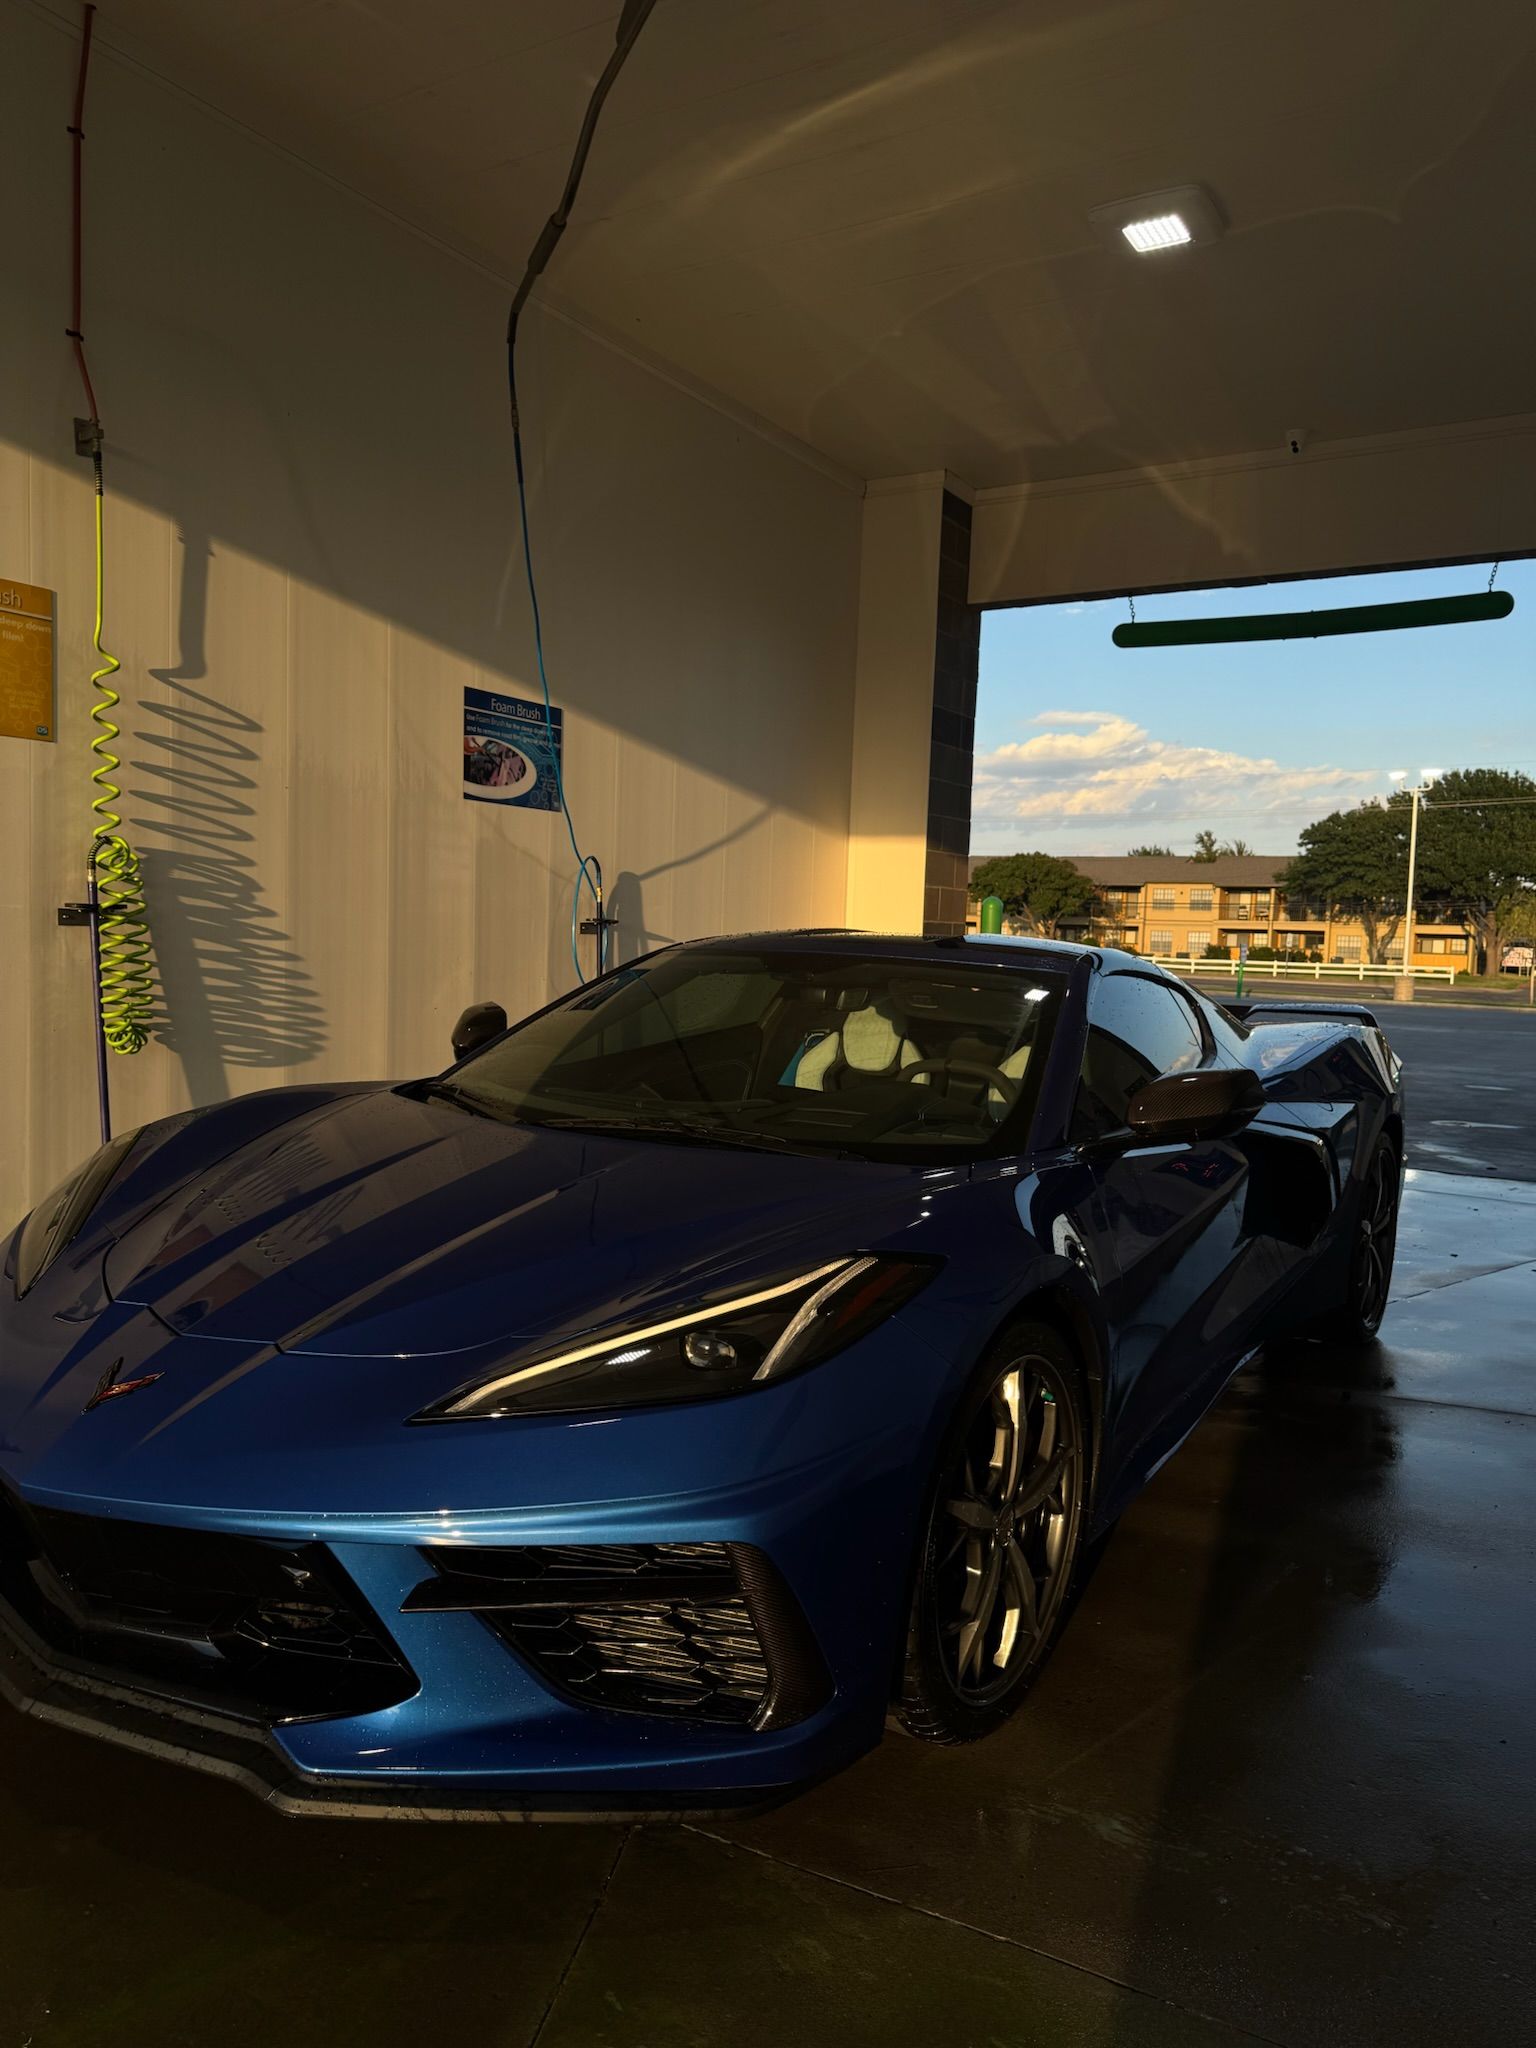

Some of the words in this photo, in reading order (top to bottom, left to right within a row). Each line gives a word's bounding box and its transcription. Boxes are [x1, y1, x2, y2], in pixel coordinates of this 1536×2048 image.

[0, 588, 21, 608] sh
[491, 698, 515, 715] Foam
[516, 704, 541, 720] Brush
